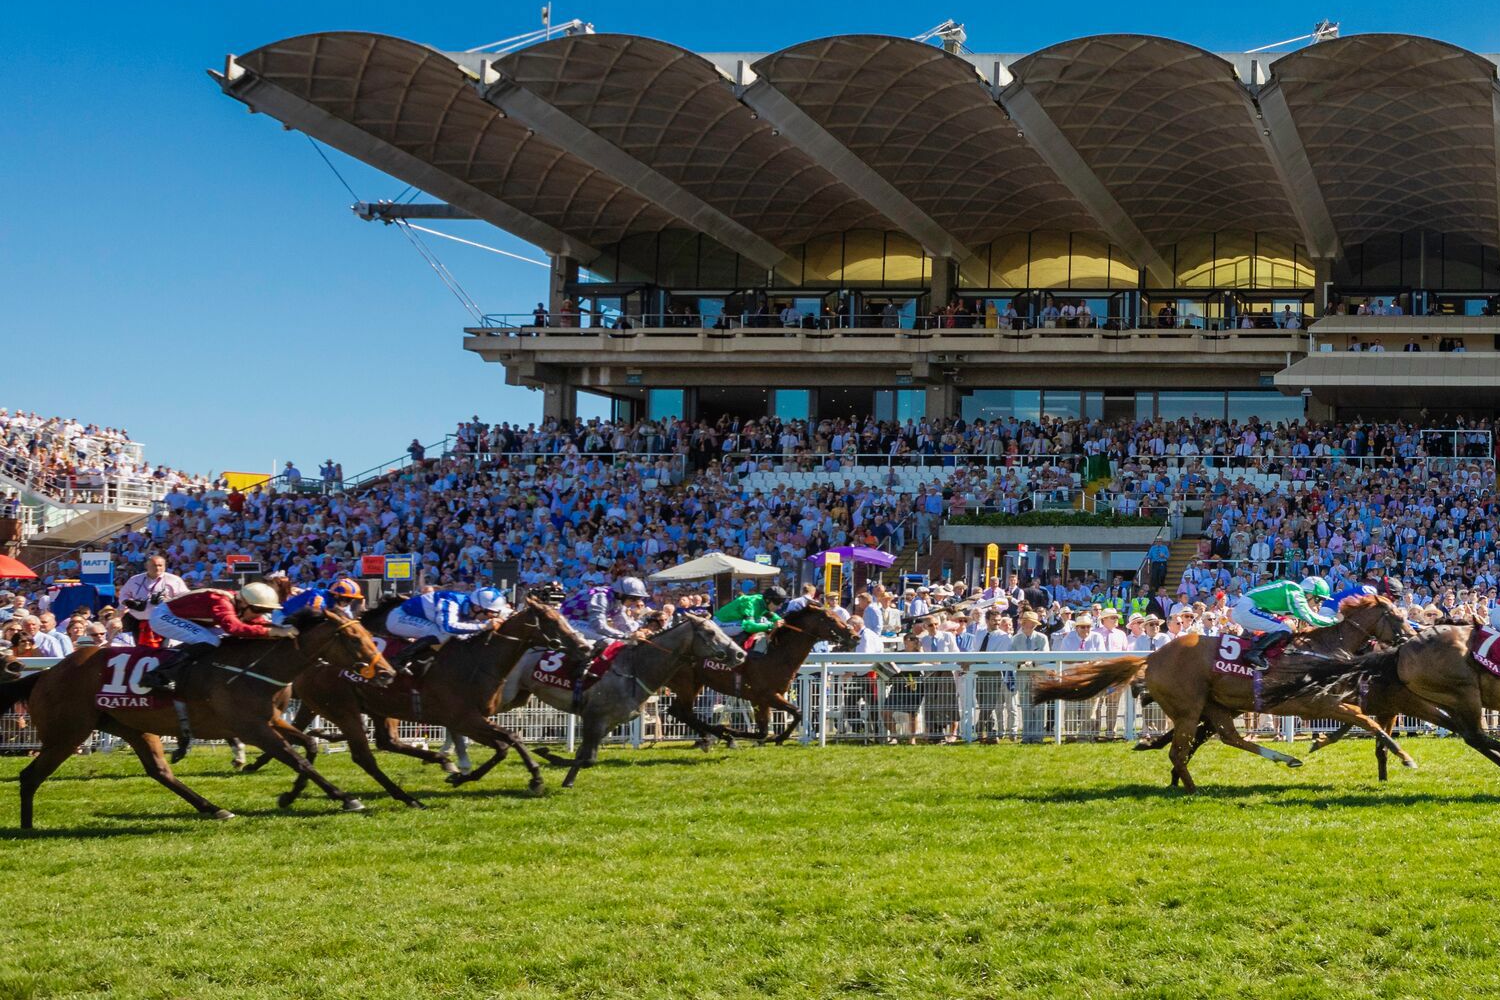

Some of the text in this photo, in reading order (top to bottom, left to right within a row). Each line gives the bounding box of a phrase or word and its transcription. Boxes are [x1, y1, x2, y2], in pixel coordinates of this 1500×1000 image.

[82, 559, 108, 567] MATT
[1219, 633, 1241, 660] 5
[1477, 625, 1500, 658] 7
[539, 650, 566, 672] 3
[1215, 660, 1255, 676] QATAR
[533, 670, 571, 688] QATAR
[97, 696, 150, 709] QATAR
